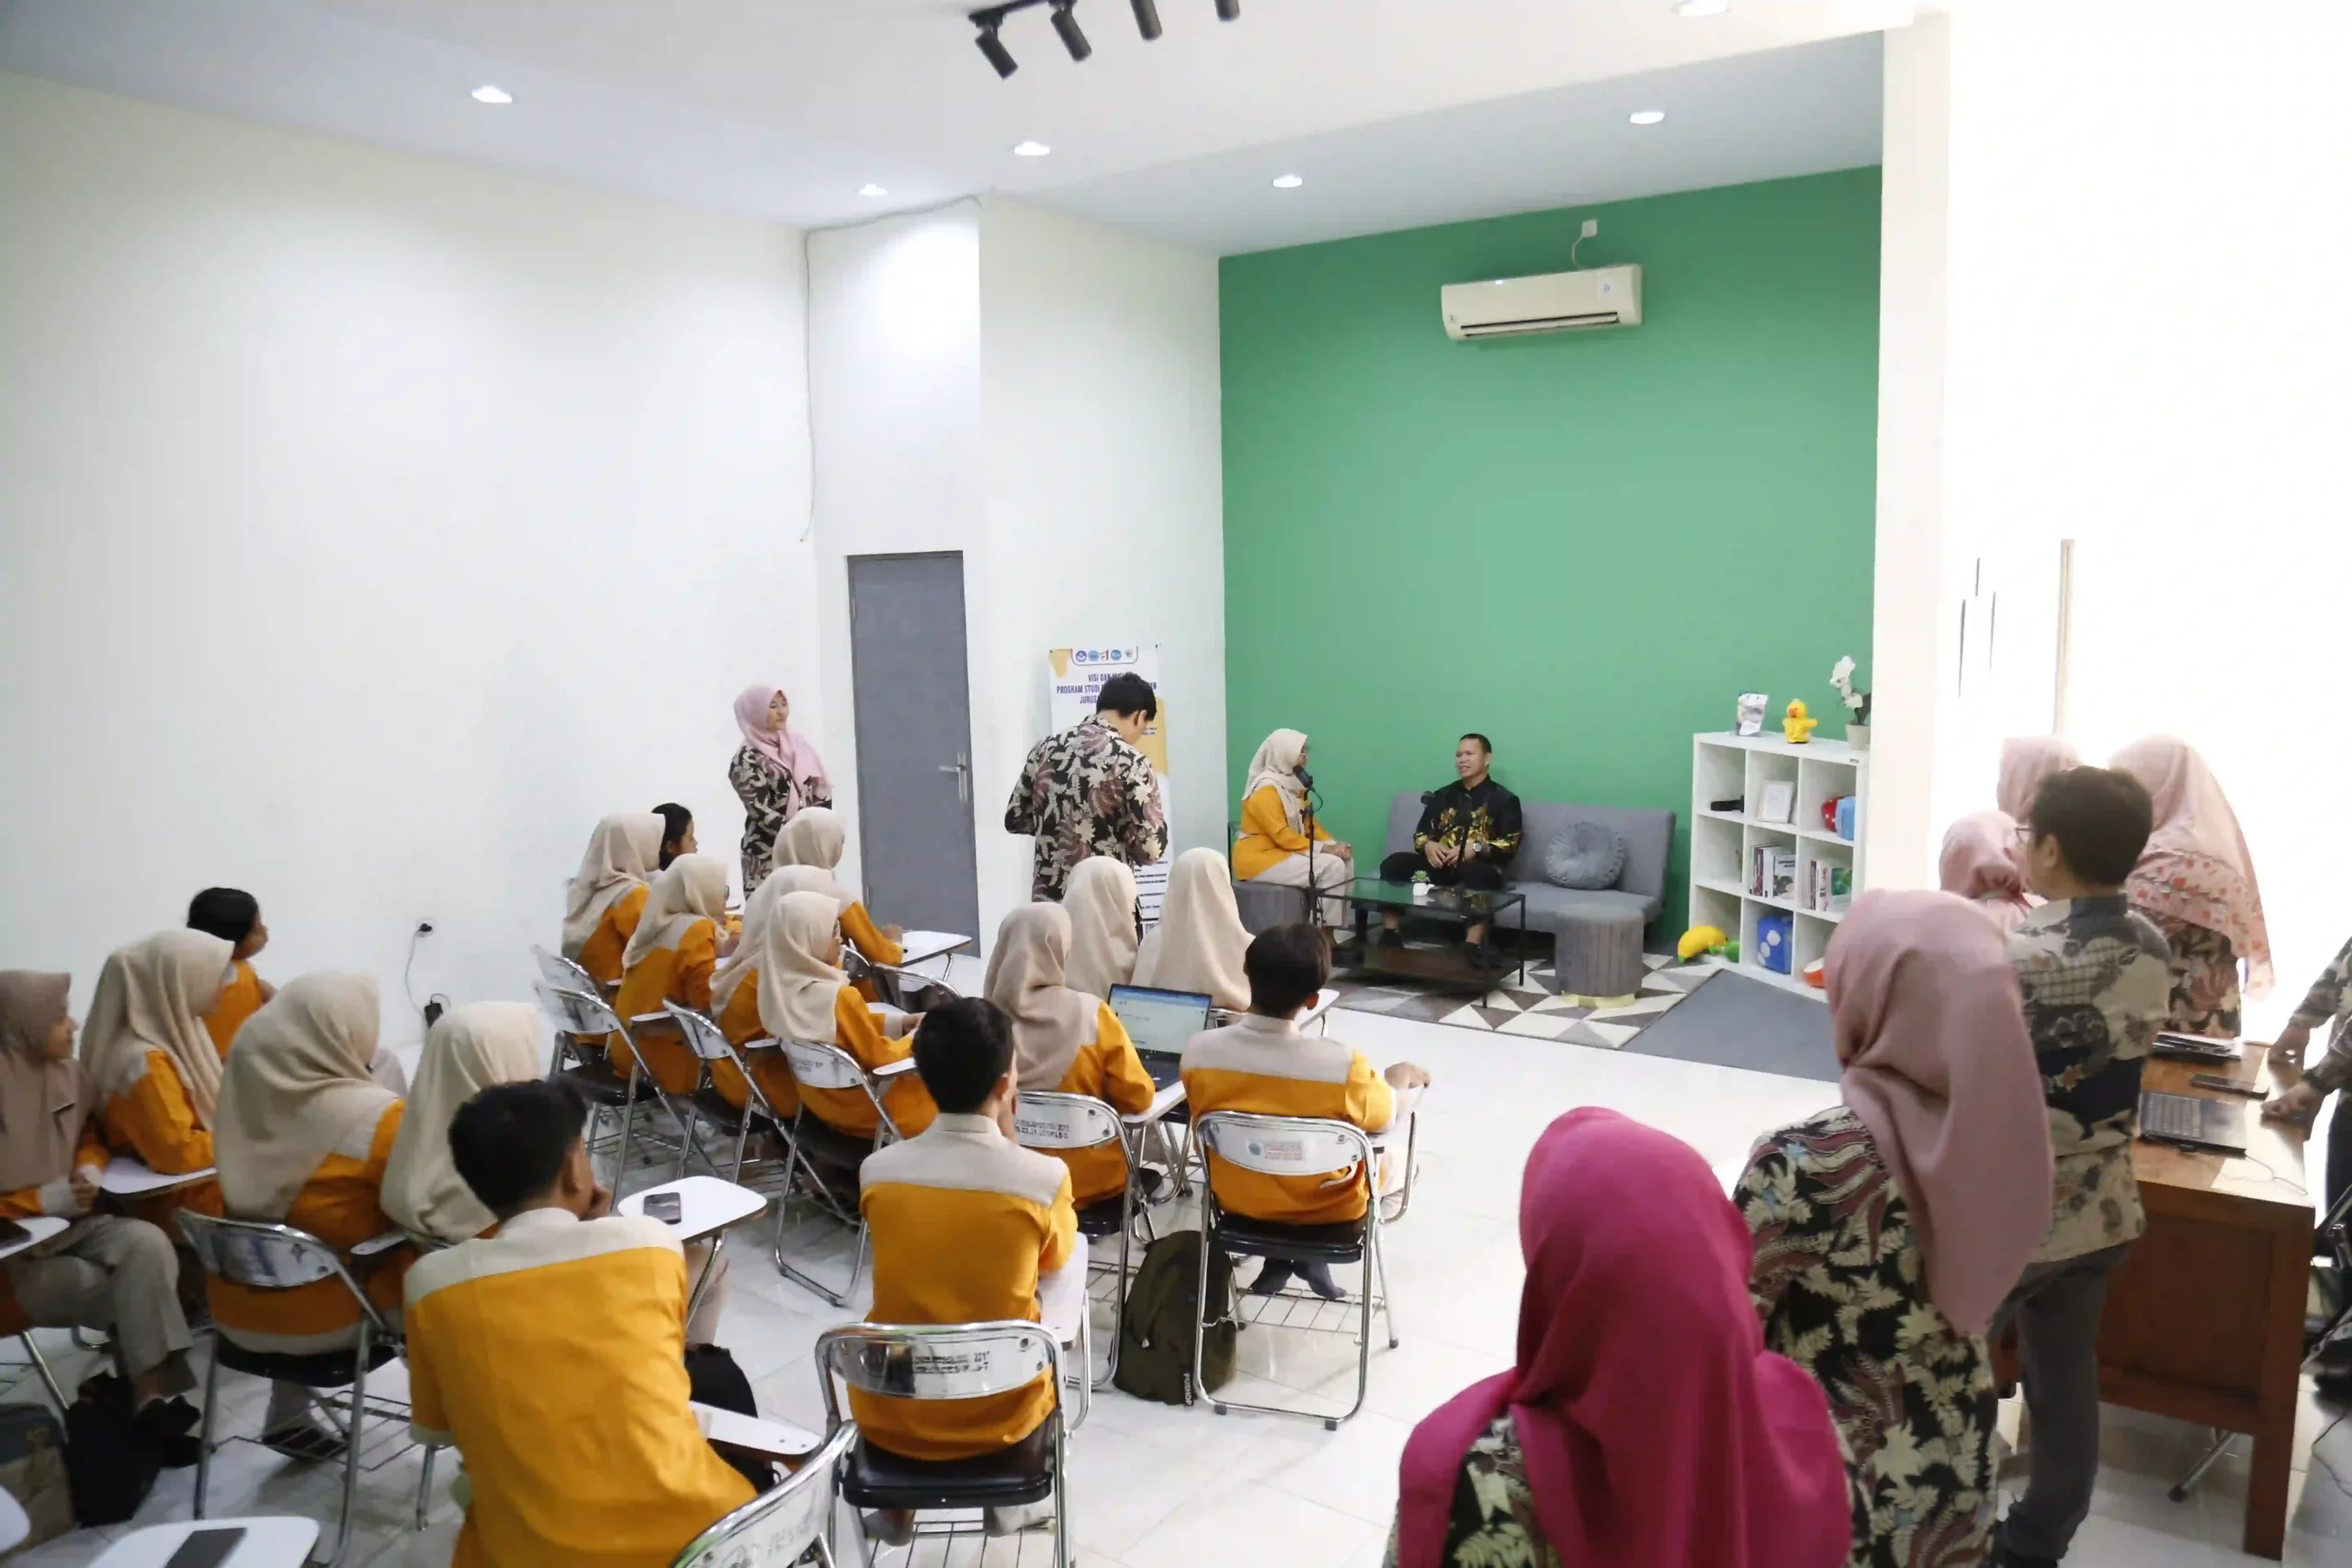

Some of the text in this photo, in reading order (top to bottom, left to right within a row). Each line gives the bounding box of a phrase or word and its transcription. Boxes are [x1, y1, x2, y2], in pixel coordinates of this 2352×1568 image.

[1088, 673, 1099, 682] VISI
[1057, 683, 1101, 694] PROGRAM STUDI
[1080, 694, 1098, 705] JURUS
